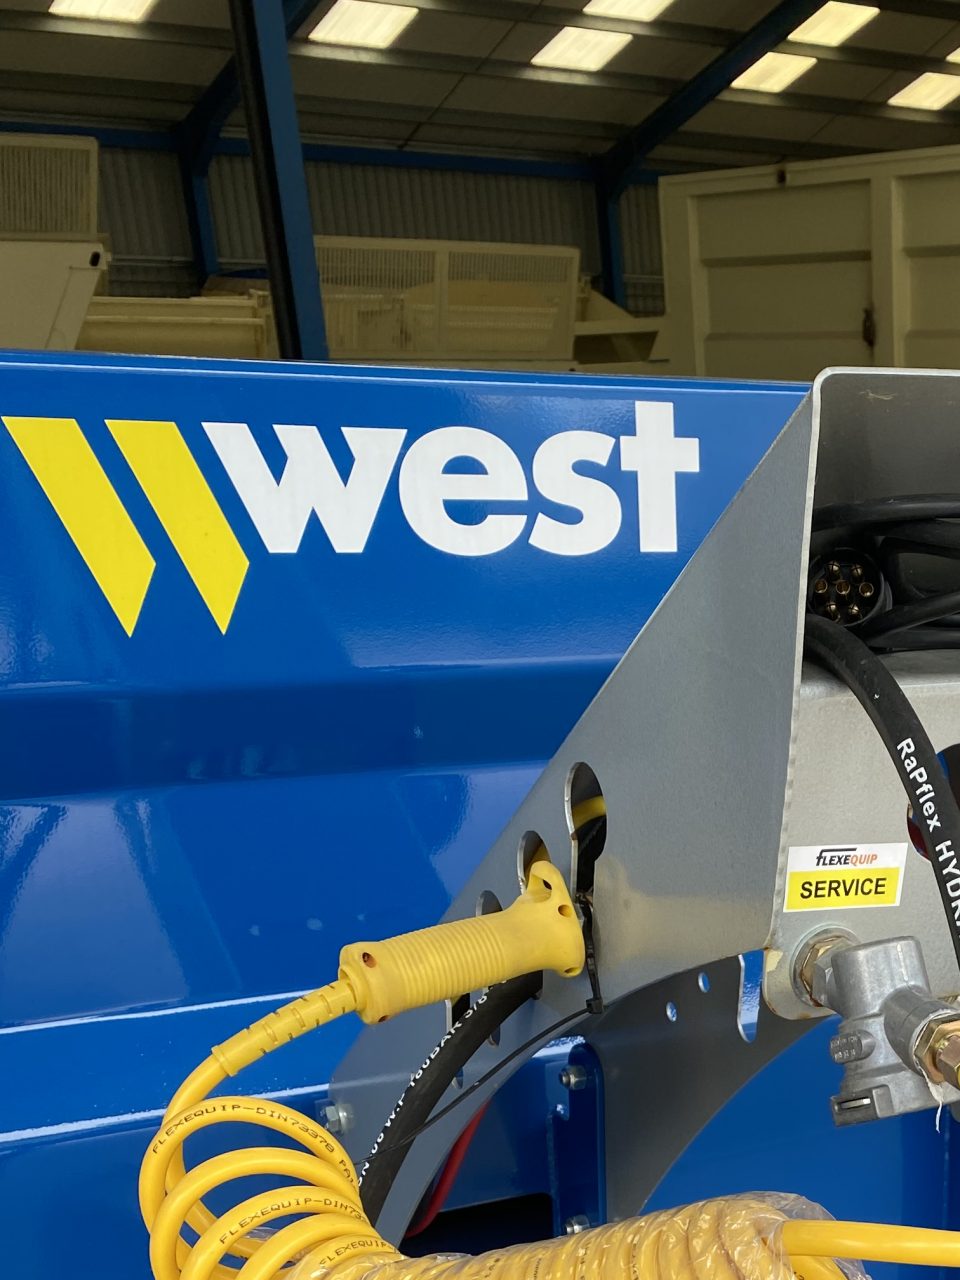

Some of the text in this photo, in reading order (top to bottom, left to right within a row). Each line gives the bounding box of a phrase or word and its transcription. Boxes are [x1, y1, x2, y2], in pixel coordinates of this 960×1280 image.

[201, 400, 699, 556] west
[800, 877, 887, 900] SERVICE
[152, 1103, 335, 1154] FLEXEQUIP-DIN73378
